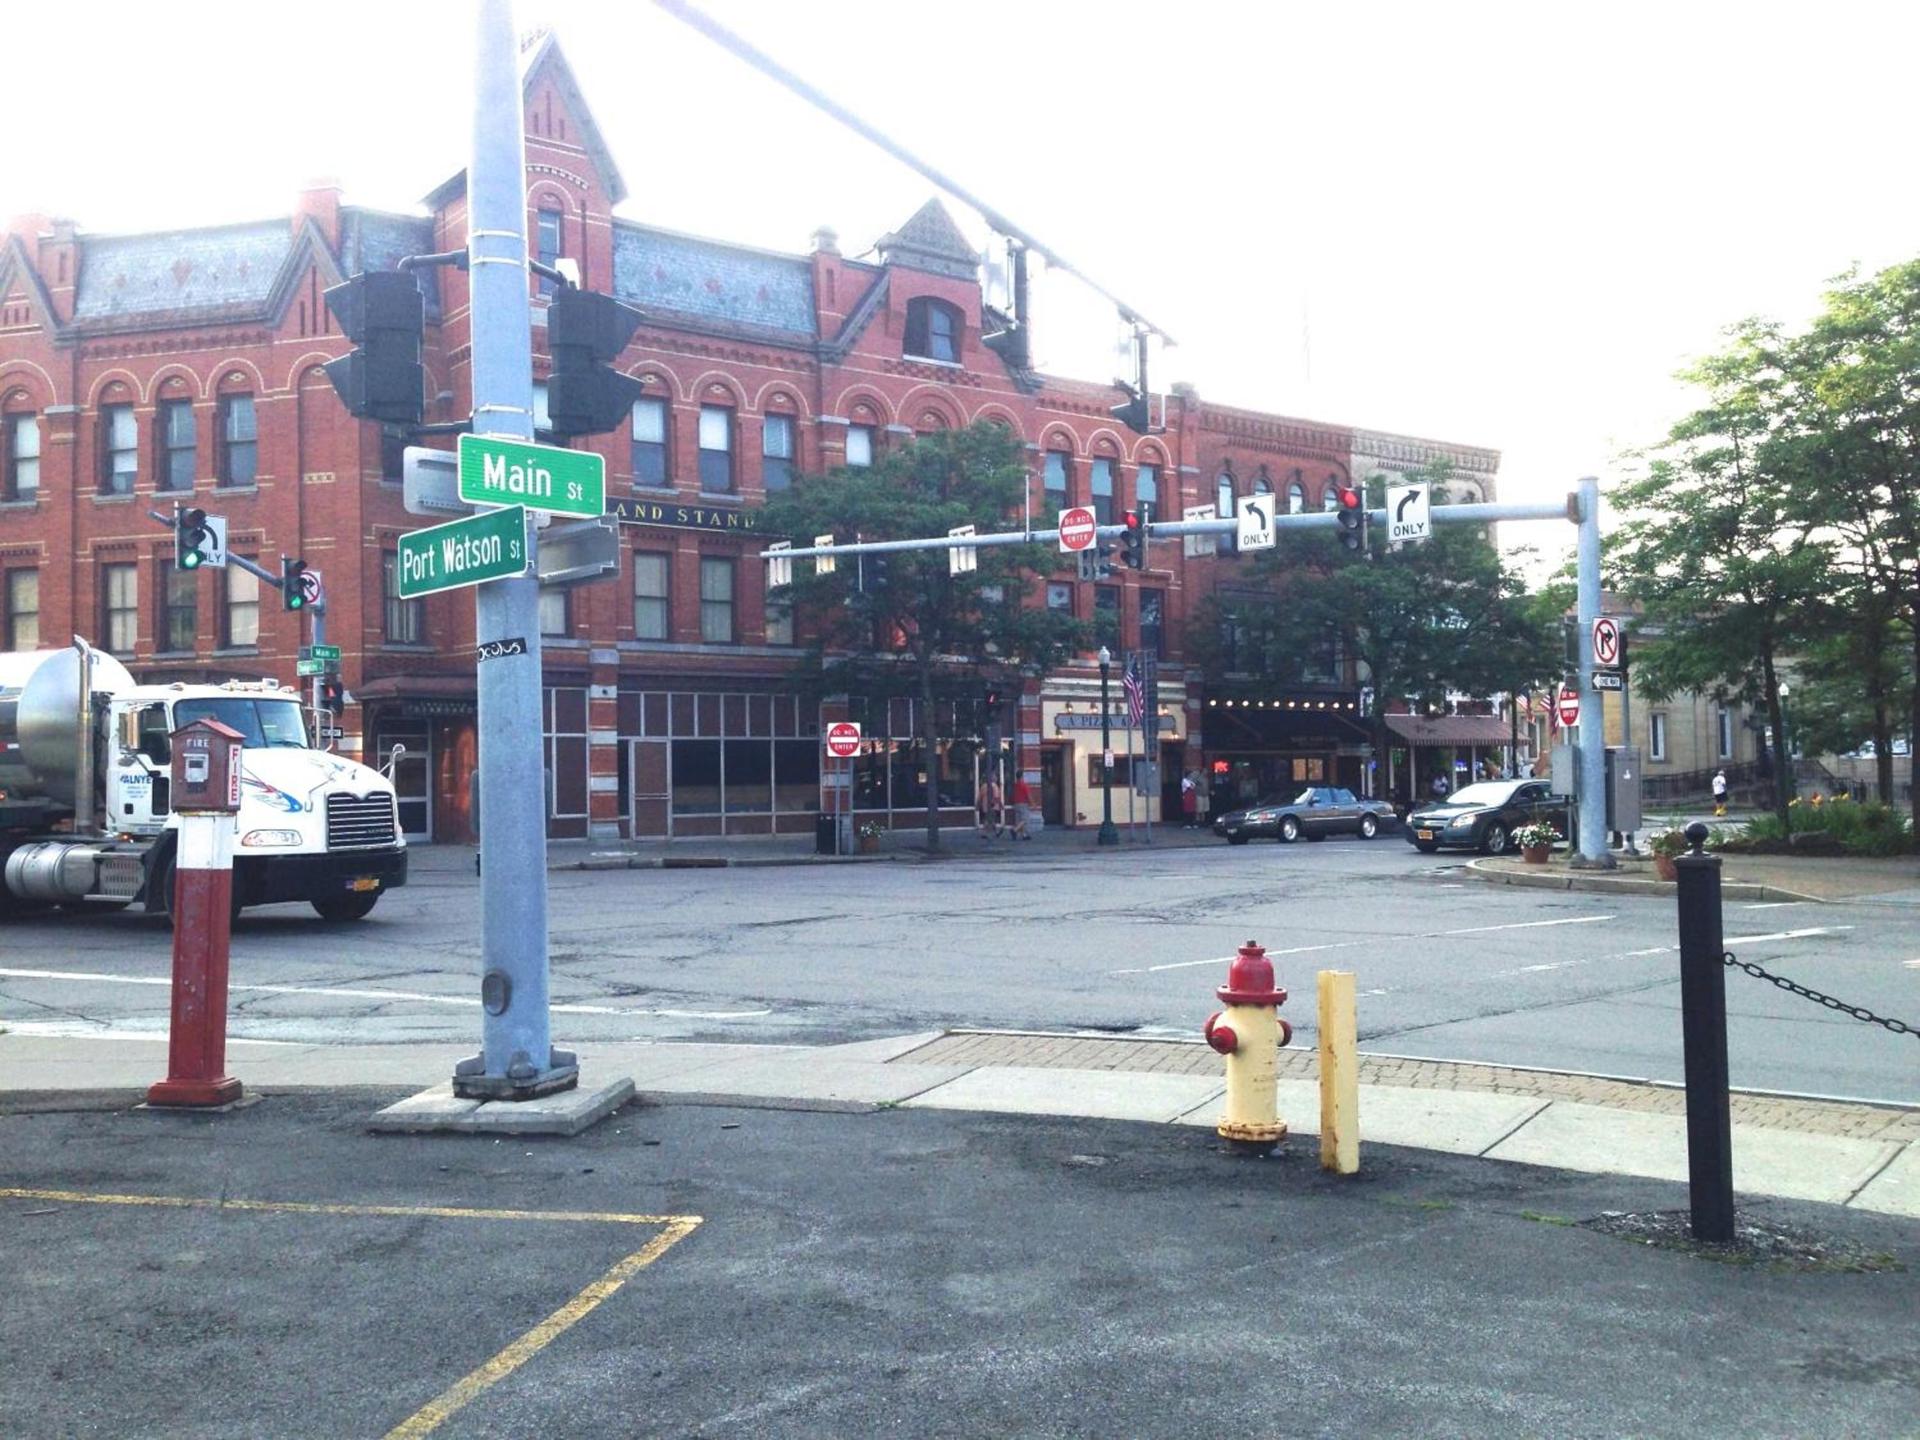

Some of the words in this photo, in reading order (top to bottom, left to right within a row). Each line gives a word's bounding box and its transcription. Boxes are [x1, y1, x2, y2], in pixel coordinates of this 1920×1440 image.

[484, 453, 551, 496] Main
[567, 482, 583, 500] St
[1243, 532, 1270, 545] ONLY
[1393, 522, 1425, 537] ONLY
[403, 544, 435, 583] Port
[443, 534, 501, 574] Watson
[510, 540, 520, 559] St
[186, 738, 209, 748] FIRE
[231, 748, 240, 801] FIRE
